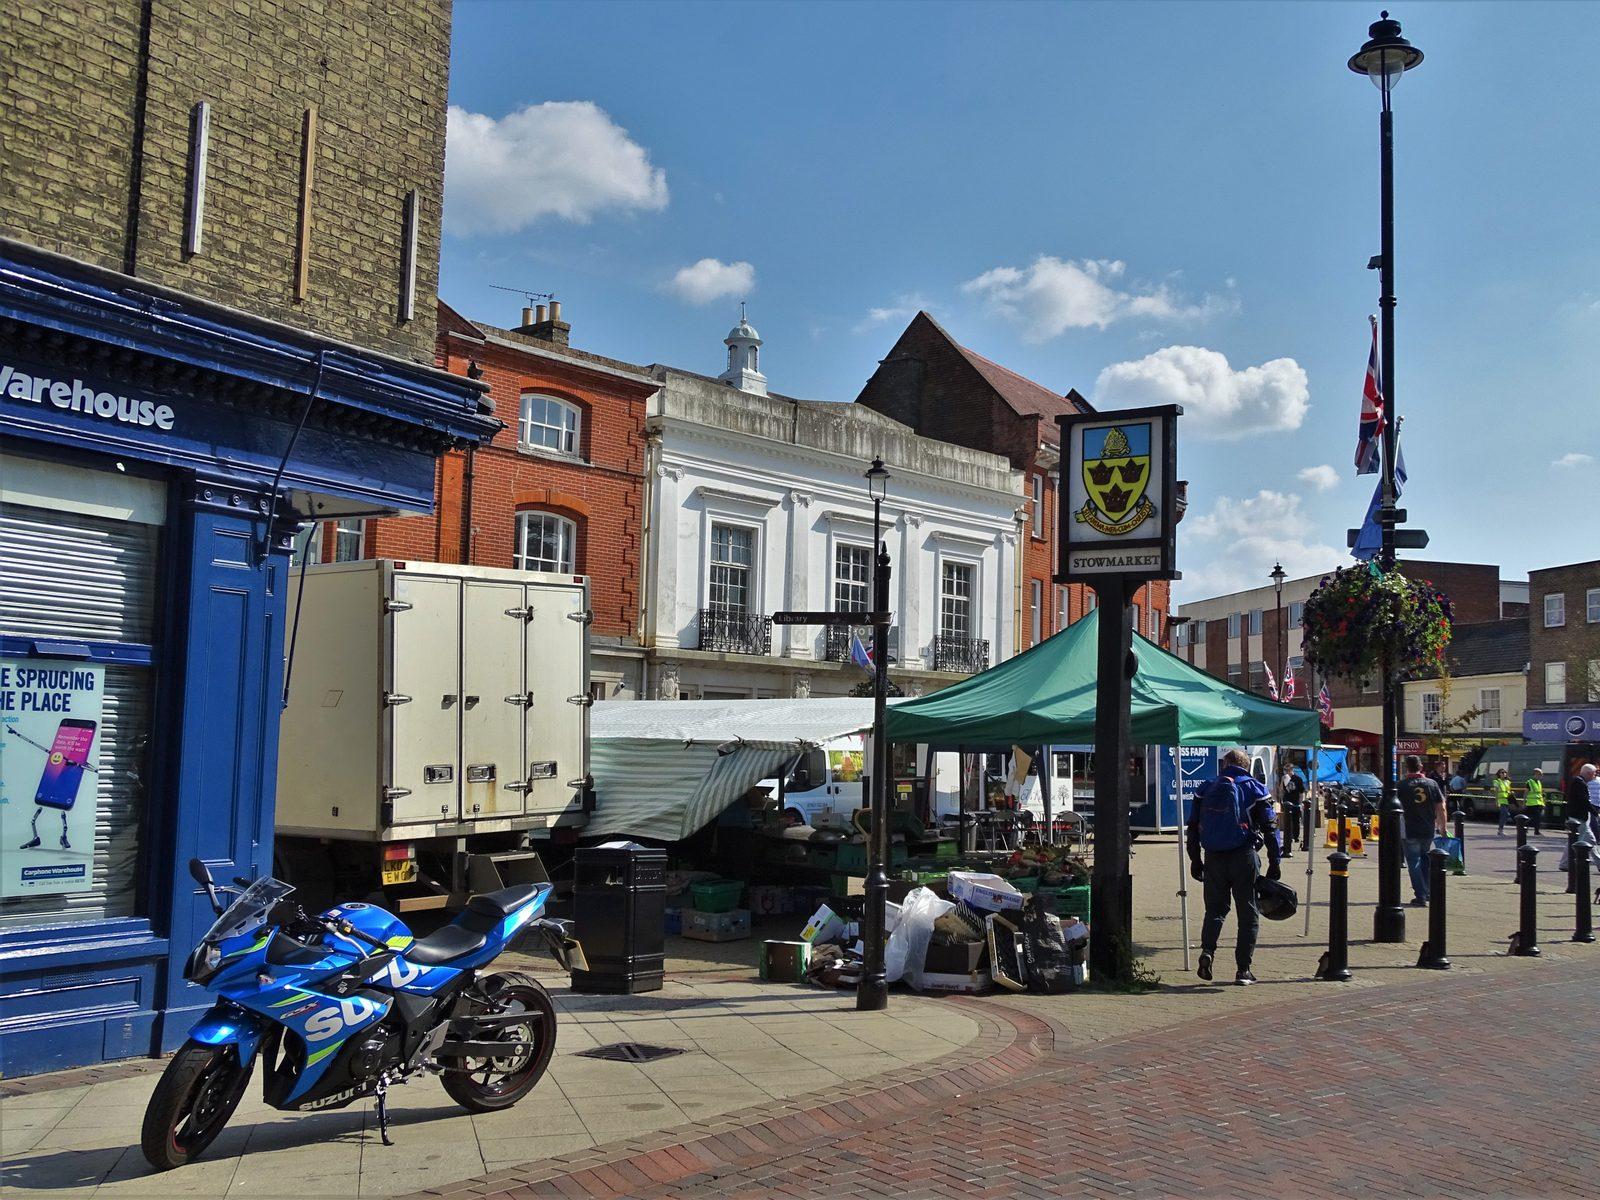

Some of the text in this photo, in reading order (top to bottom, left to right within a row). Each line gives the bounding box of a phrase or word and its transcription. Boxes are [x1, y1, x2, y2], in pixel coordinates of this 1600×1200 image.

[1073, 554, 1160, 568] STOWMARKET
[778, 613, 808, 623] Library
[16, 668, 95, 691] SPRUCING
[21, 691, 72, 712] PLACE
[1531, 721, 1559, 731] opticians
[1190, 747, 1209, 757] FARM
[1413, 787, 1428, 804] 3
[52, 866, 83, 875] Warehouse
